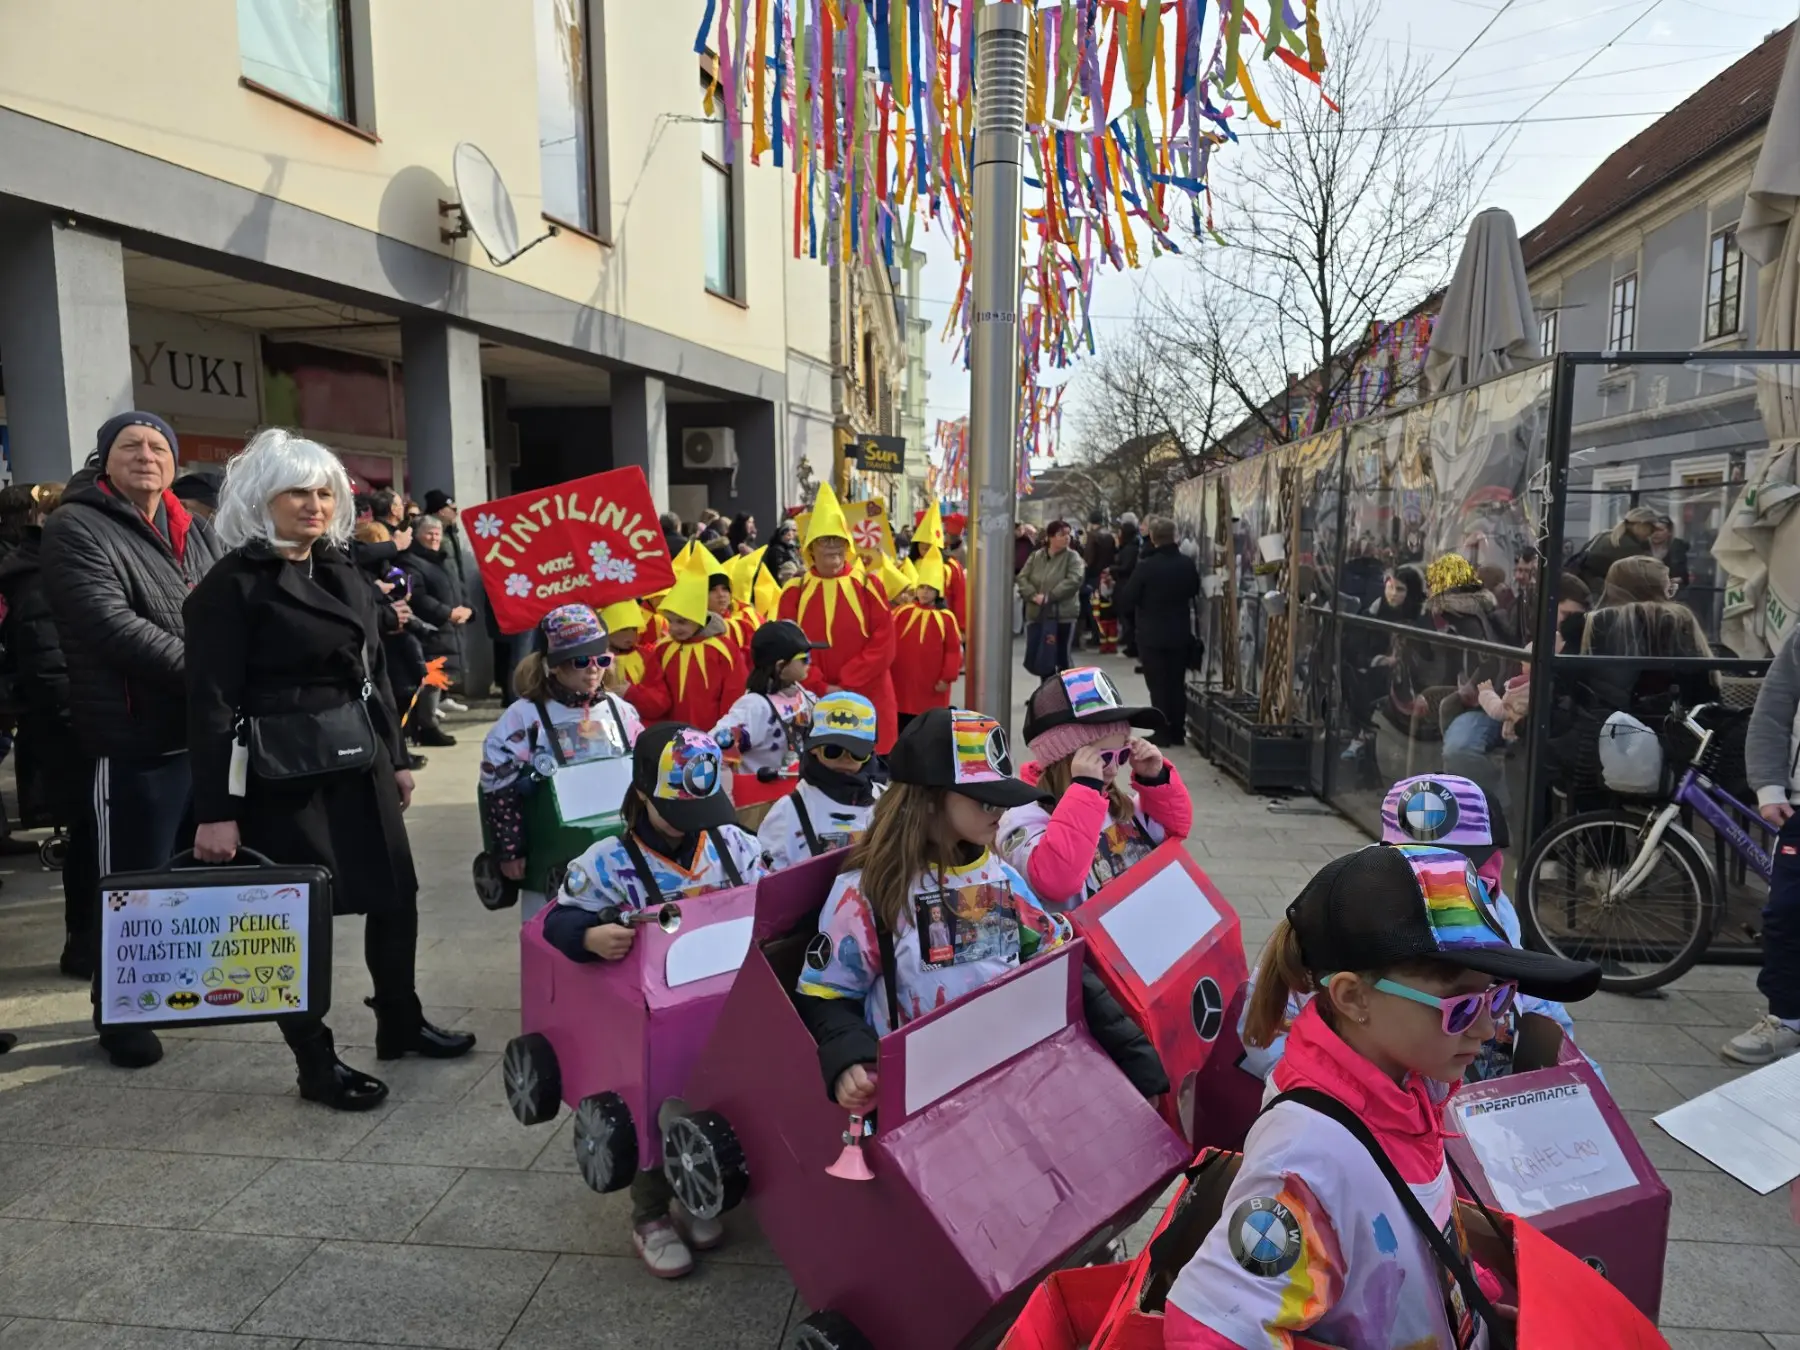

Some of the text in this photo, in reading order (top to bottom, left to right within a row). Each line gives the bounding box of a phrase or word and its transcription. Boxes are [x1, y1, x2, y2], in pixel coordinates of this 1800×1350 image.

[132, 341, 247, 398] YUKI
[864, 441, 901, 464] Sun
[537, 552, 575, 576] VRTIĆ
[535, 573, 592, 599] CVRČAK
[1402, 782, 1452, 802] BMW
[120, 912, 291, 938] AUTO SALON PČELICE
[116, 936, 297, 962] OVLAŠTENI ZASTUPNIK
[117, 966, 137, 985] ZA
[208, 992, 240, 1002] BUGATTI
[1250, 1198, 1300, 1244] BMW
